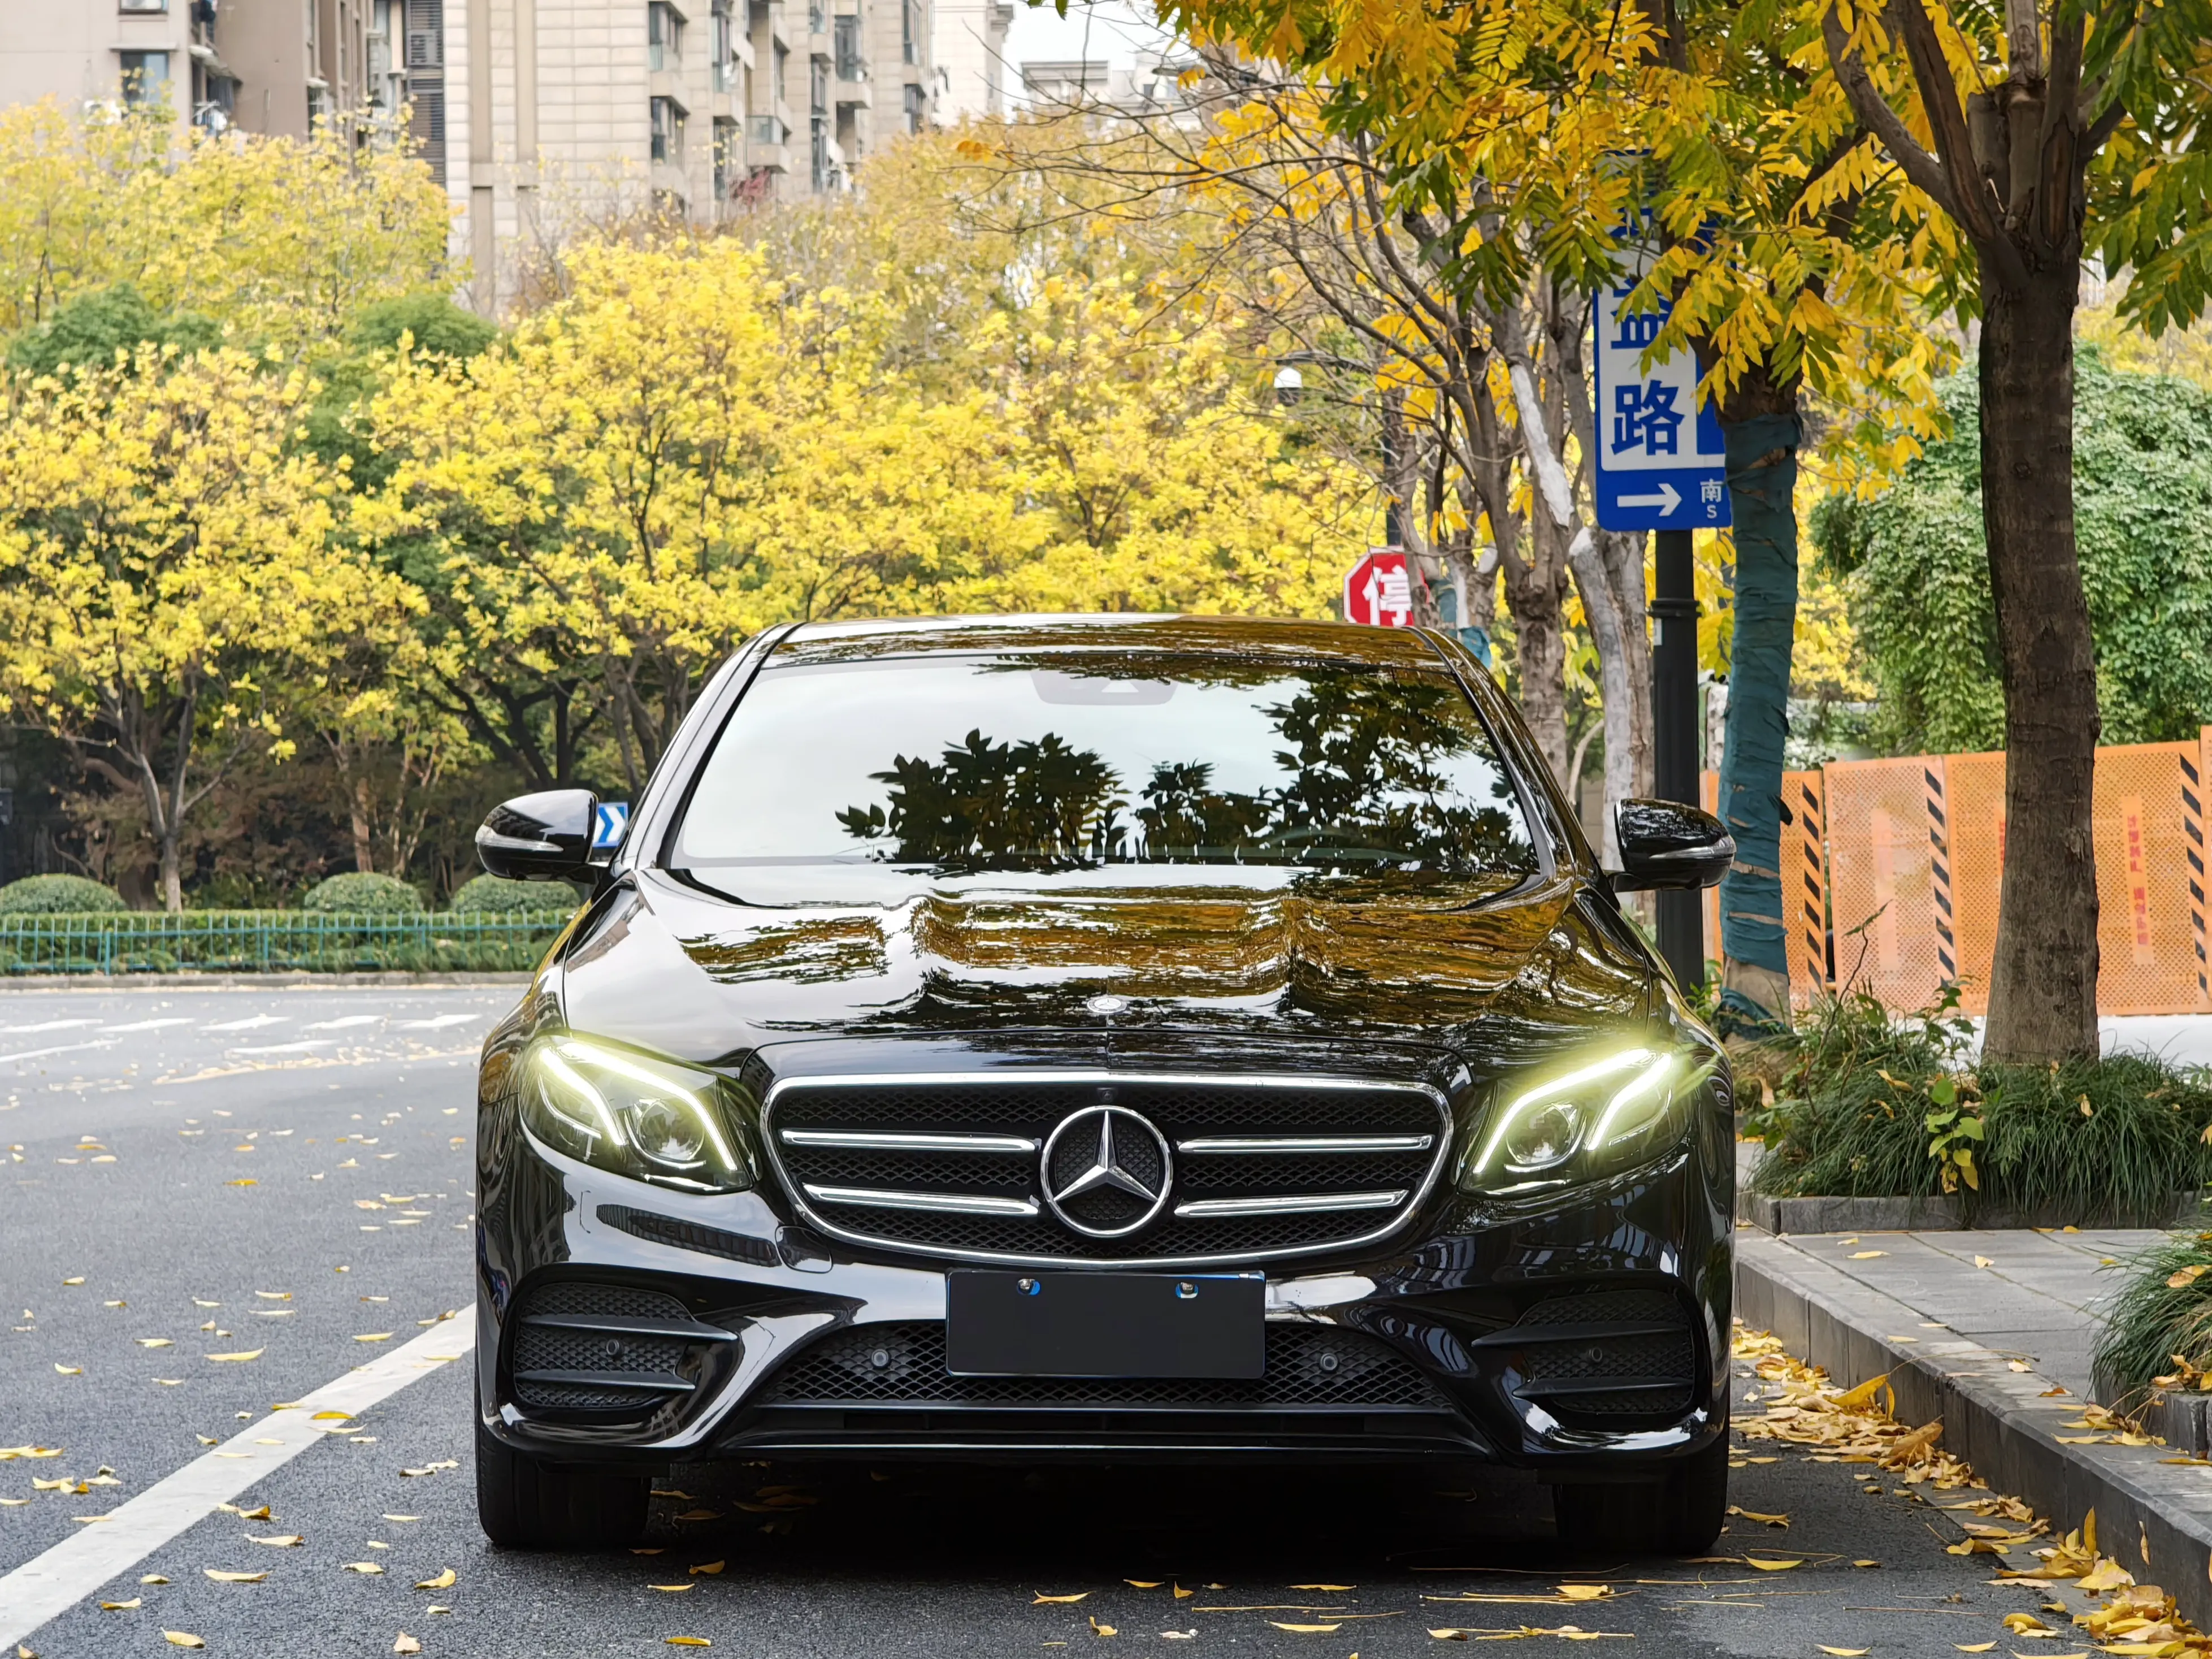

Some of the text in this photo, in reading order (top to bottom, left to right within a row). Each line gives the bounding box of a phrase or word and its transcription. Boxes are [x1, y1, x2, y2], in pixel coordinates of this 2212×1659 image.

[1610, 170, 1685, 456] 益路
[1700, 478, 1723, 503] 南
[1707, 504, 1717, 519] S
[1362, 565, 1413, 627] 停
